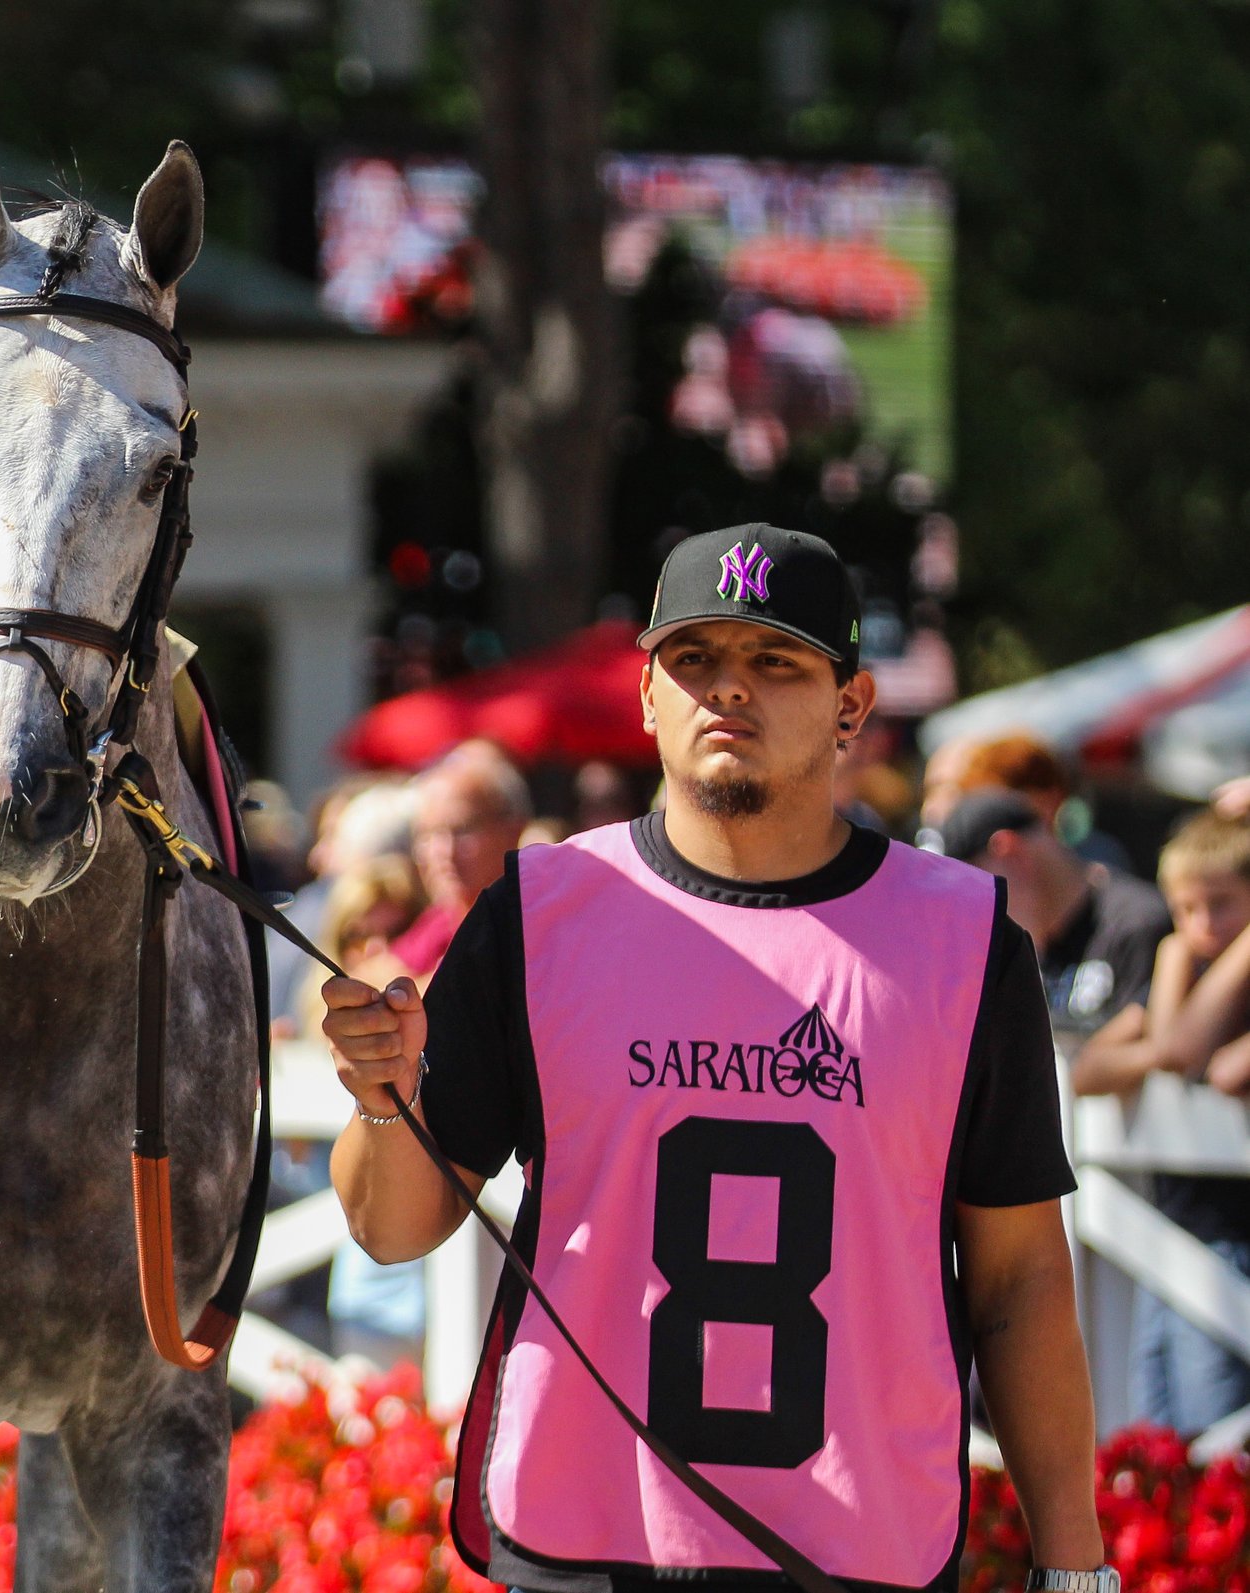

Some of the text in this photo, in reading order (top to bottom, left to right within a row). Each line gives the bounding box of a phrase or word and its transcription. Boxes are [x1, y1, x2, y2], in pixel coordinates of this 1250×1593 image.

[716, 541, 774, 603] NY
[628, 1036, 866, 1108] SARATOGA
[646, 1115, 837, 1470] 8
